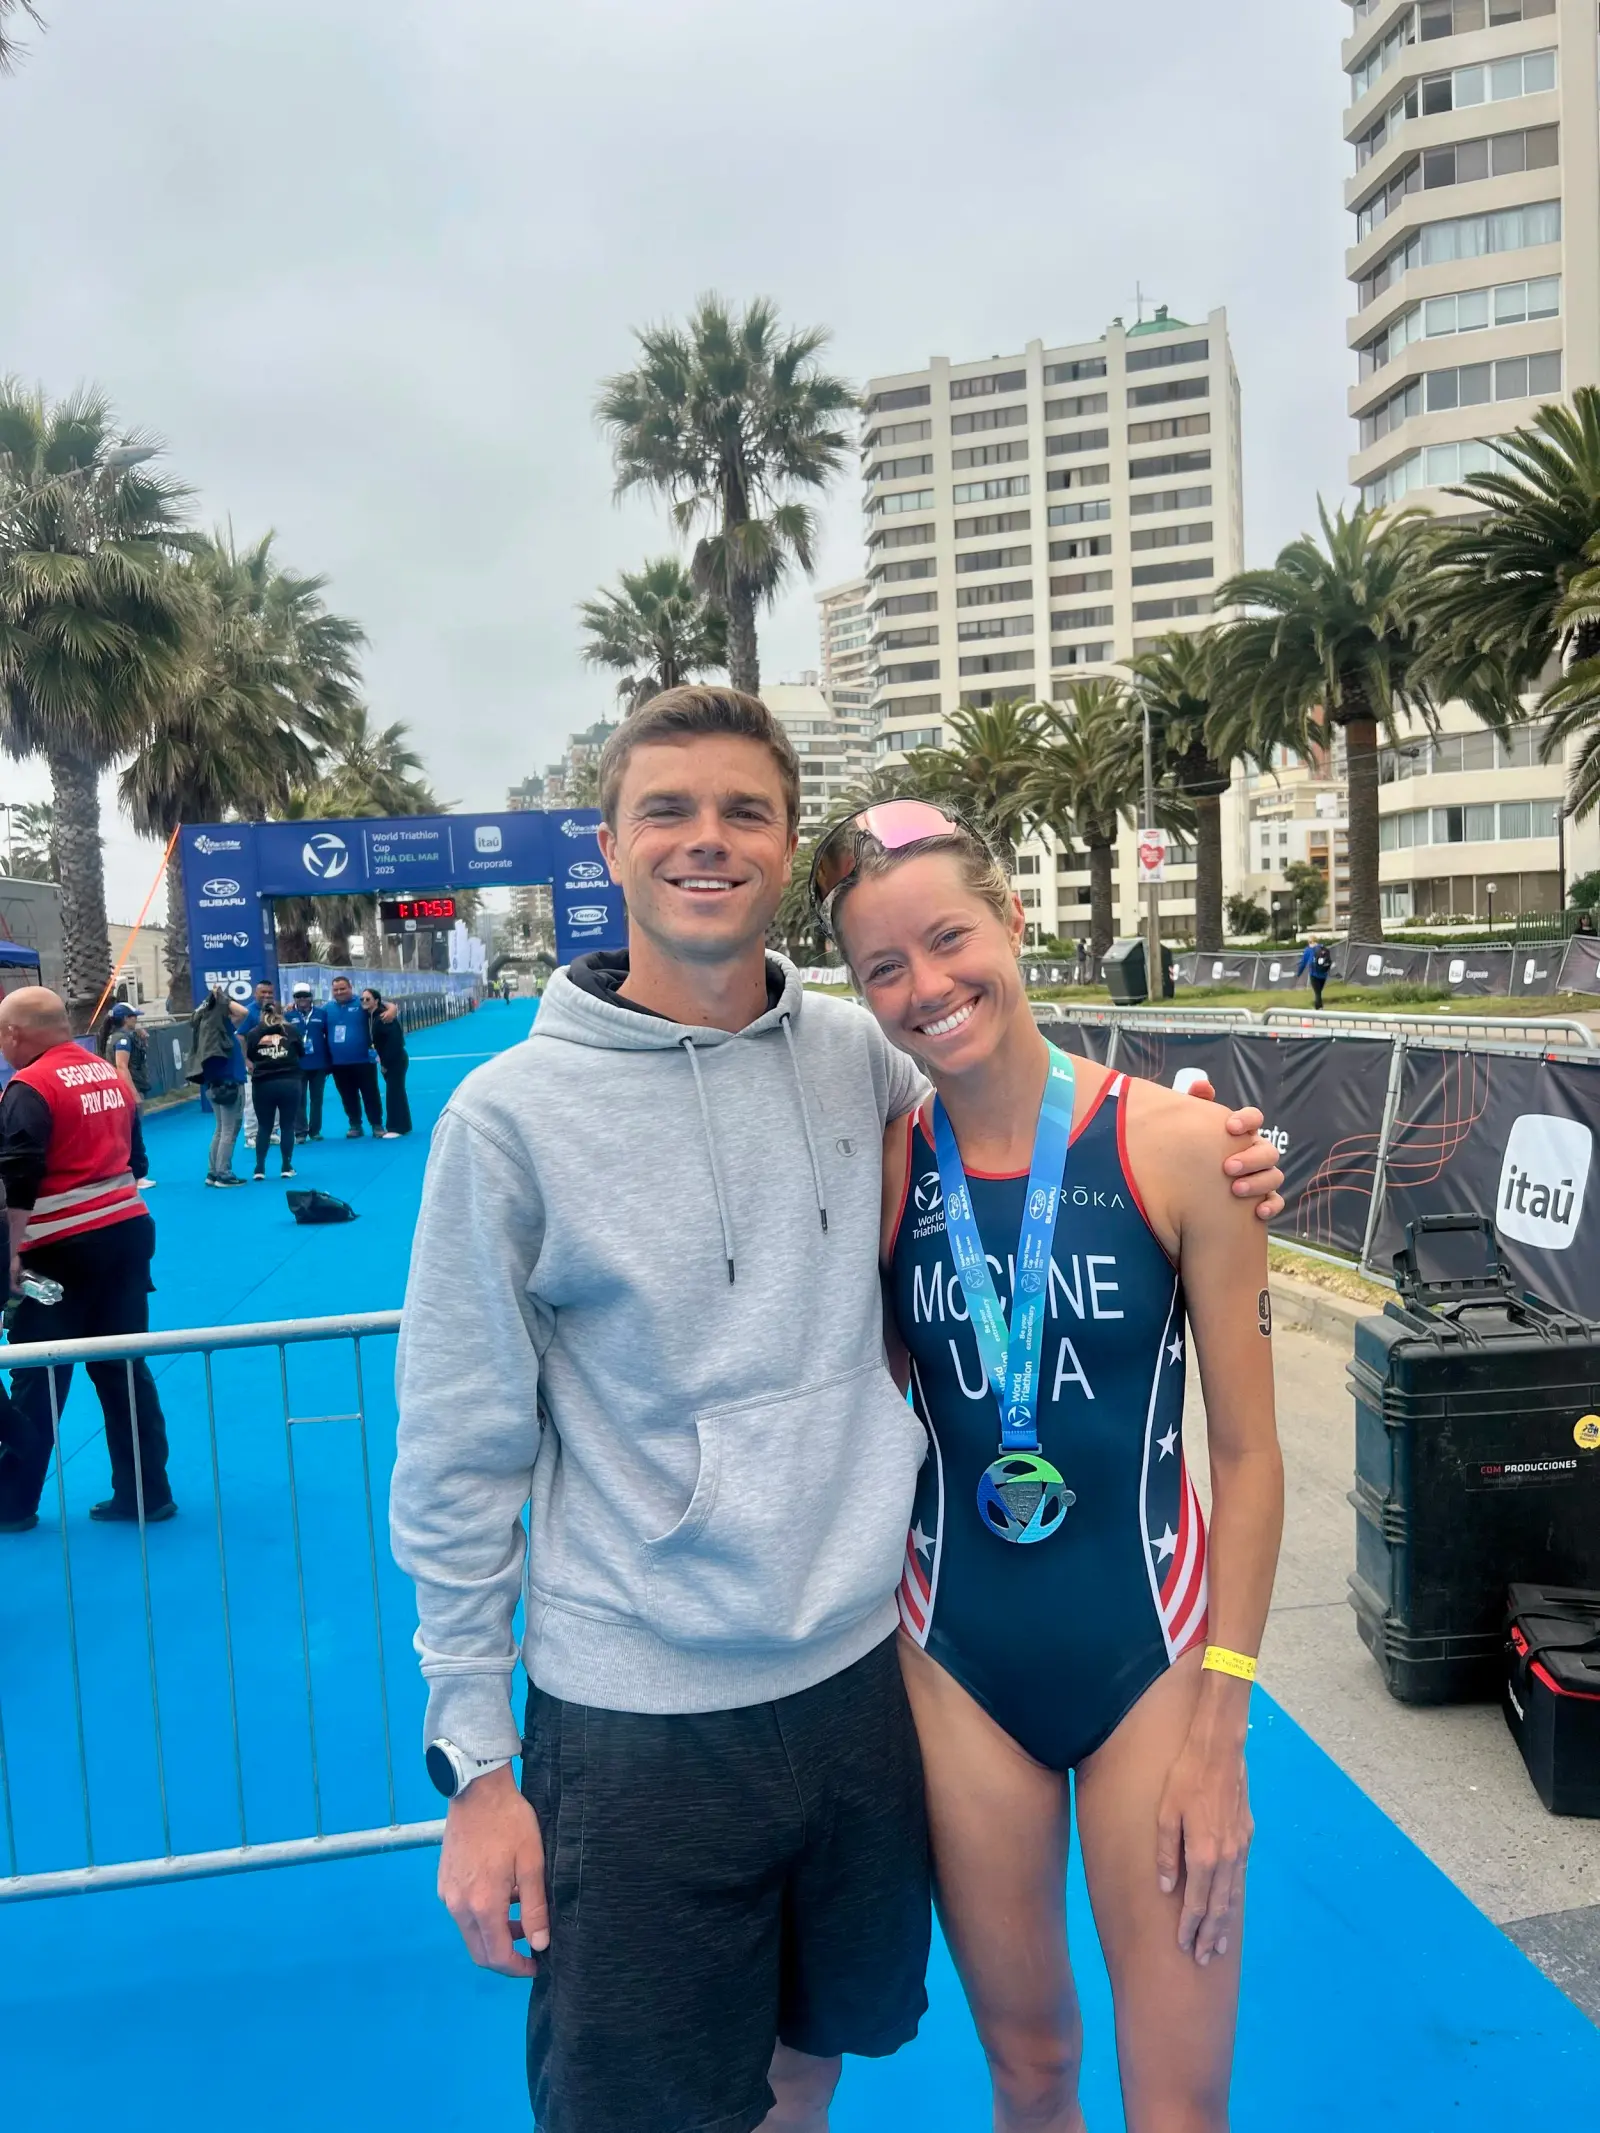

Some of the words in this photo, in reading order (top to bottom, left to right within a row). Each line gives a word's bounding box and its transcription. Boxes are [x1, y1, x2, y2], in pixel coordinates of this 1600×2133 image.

[372, 832, 398, 842] World
[400, 830, 439, 840] Triathlon
[373, 844, 391, 854] Cup
[374, 853, 398, 863] VIÑA
[400, 853, 416, 862] DEL
[418, 853, 439, 861] MAR
[468, 859, 513, 871] Corporate
[375, 866, 395, 875] 2025
[565, 880, 609, 889] SUBARU
[199, 898, 246, 908] SUBARU
[202, 932, 233, 942] Triatlón
[204, 941, 224, 949] Chile
[204, 969, 252, 982] BLUE
[56, 1062, 118, 1088] SEGURIDAD
[958, 1184, 971, 1220] SUBARU
[1504, 1165, 1575, 1226] itaú
[1045, 1186, 1057, 1224] SUBARU
[918, 1211, 944, 1227] World
[980, 1309, 989, 1324] your
[983, 1298, 1001, 1342] extraordinary
[1025, 1305, 1036, 1350] extraordinary
[1019, 1331, 1026, 1340] Be
[949, 1337, 1096, 1402] UA
[1010, 1373, 1022, 1403] World
[1020, 1361, 1032, 1403] Triathlon
[1504, 1459, 1577, 1473] PRODUCCIONES
